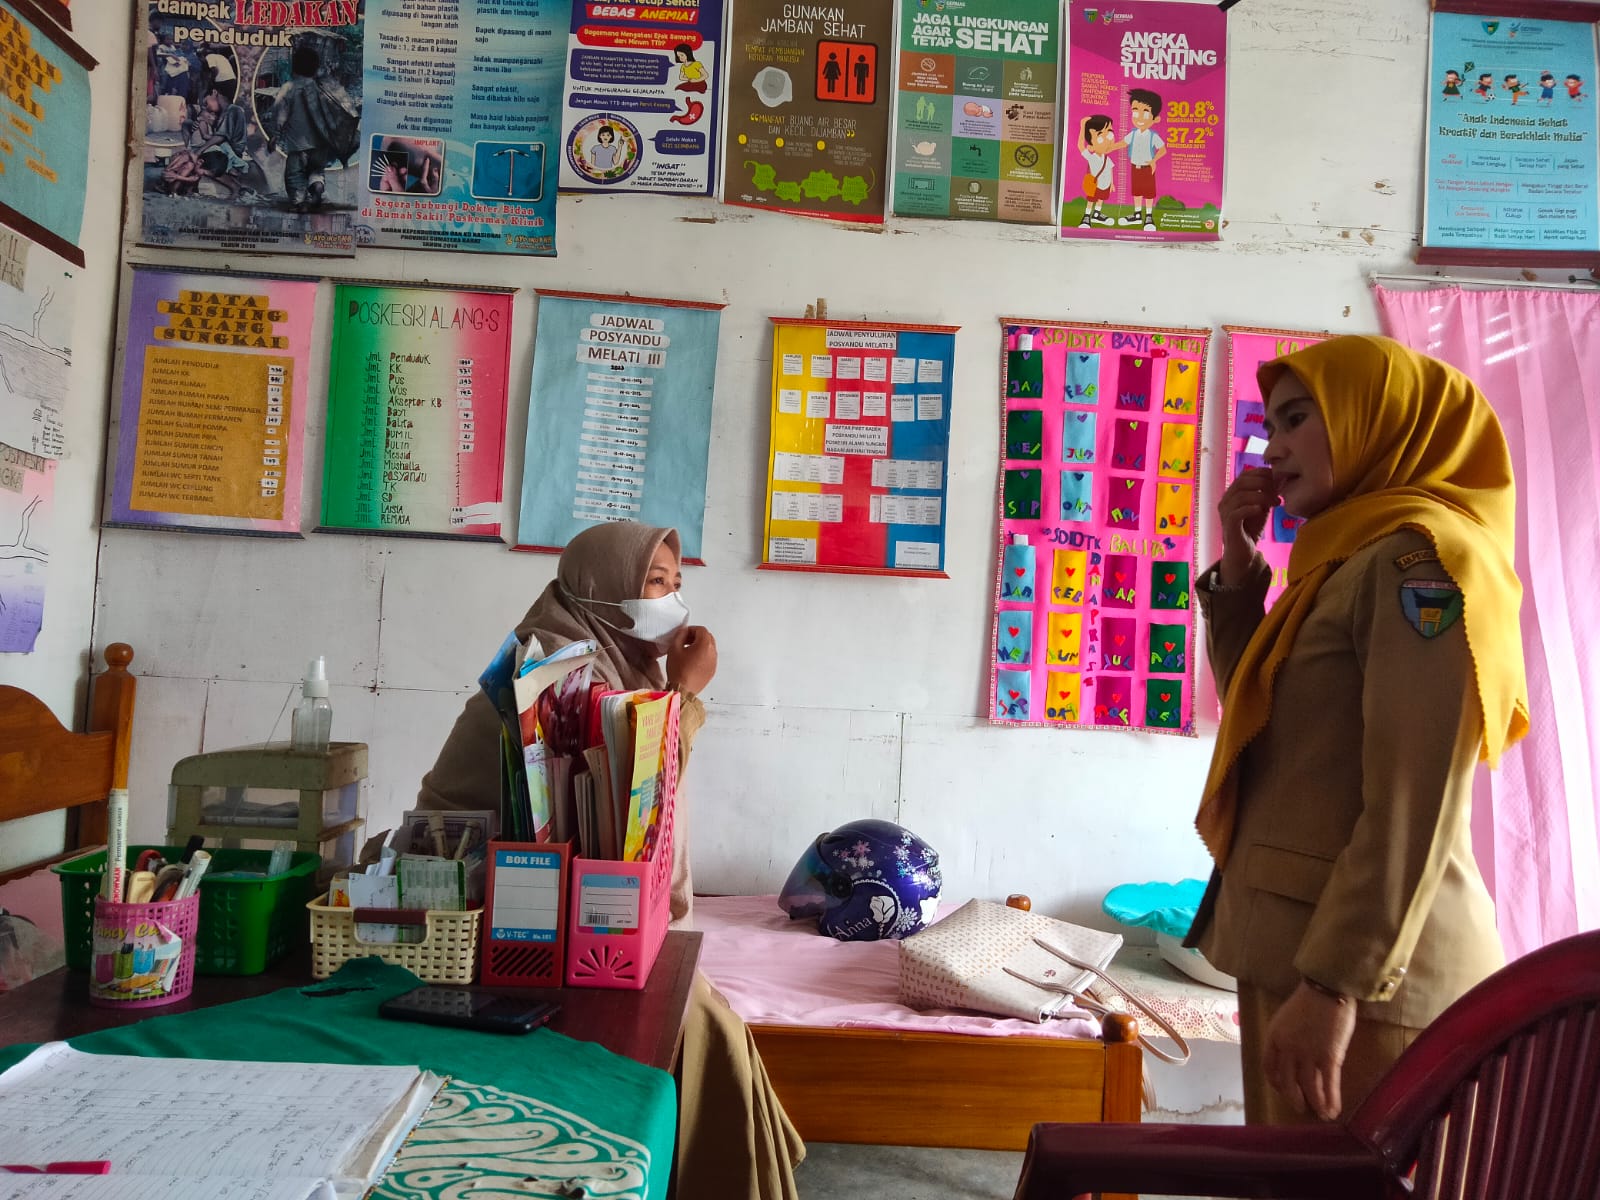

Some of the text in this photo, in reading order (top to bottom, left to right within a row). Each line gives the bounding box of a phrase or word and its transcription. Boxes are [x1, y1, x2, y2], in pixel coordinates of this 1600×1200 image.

[158, 0, 359, 26] dampak LEDAKAN
[592, 6, 695, 21] BEBAS ANEMIA!
[783, 4, 844, 21] GUNAKAN
[761, 19, 866, 39] JAMBAN SEHAT
[912, 13, 1049, 33] JAGA LINGKUNGAN
[914, 25, 951, 36] AGAR
[174, 26, 293, 47] penduduk
[911, 28, 1048, 55] TETAP SEHAT
[1121, 32, 1189, 49] ANGKA
[1121, 47, 1217, 65] STUNTING
[1121, 62, 1186, 80] TURUN
[1167, 101, 1215, 117] 30.8%
[834, 118, 857, 129] BESAR
[1490, 115, 1535, 126] Indonesia
[1538, 118, 1567, 127] Sehat
[1167, 127, 1214, 143] 37.2%
[1439, 127, 1476, 138] Kreatif
[1480, 130, 1497, 139] dan
[375, 198, 410, 208] Segera
[414, 201, 458, 212] hubungi
[361, 209, 372, 217] di
[376, 210, 412, 219] Rumah
[190, 292, 257, 307] DATA
[167, 302, 281, 321] KESLING
[179, 317, 264, 334] ALANG
[601, 316, 654, 330] JADWAL
[163, 328, 281, 349] SUNGKAI
[589, 330, 661, 346] POSYANDU
[1112, 331, 1148, 353] BAYI
[588, 347, 660, 365] MELATI III
[1064, 383, 1097, 399] FEB
[431, 398, 441, 407] KB
[1160, 514, 1188, 529] DES
[1110, 534, 1165, 558] BALITA
[1053, 587, 1082, 603] FEB
[1104, 587, 1135, 604] MAR
[506, 856, 551, 865] BOX FILE
